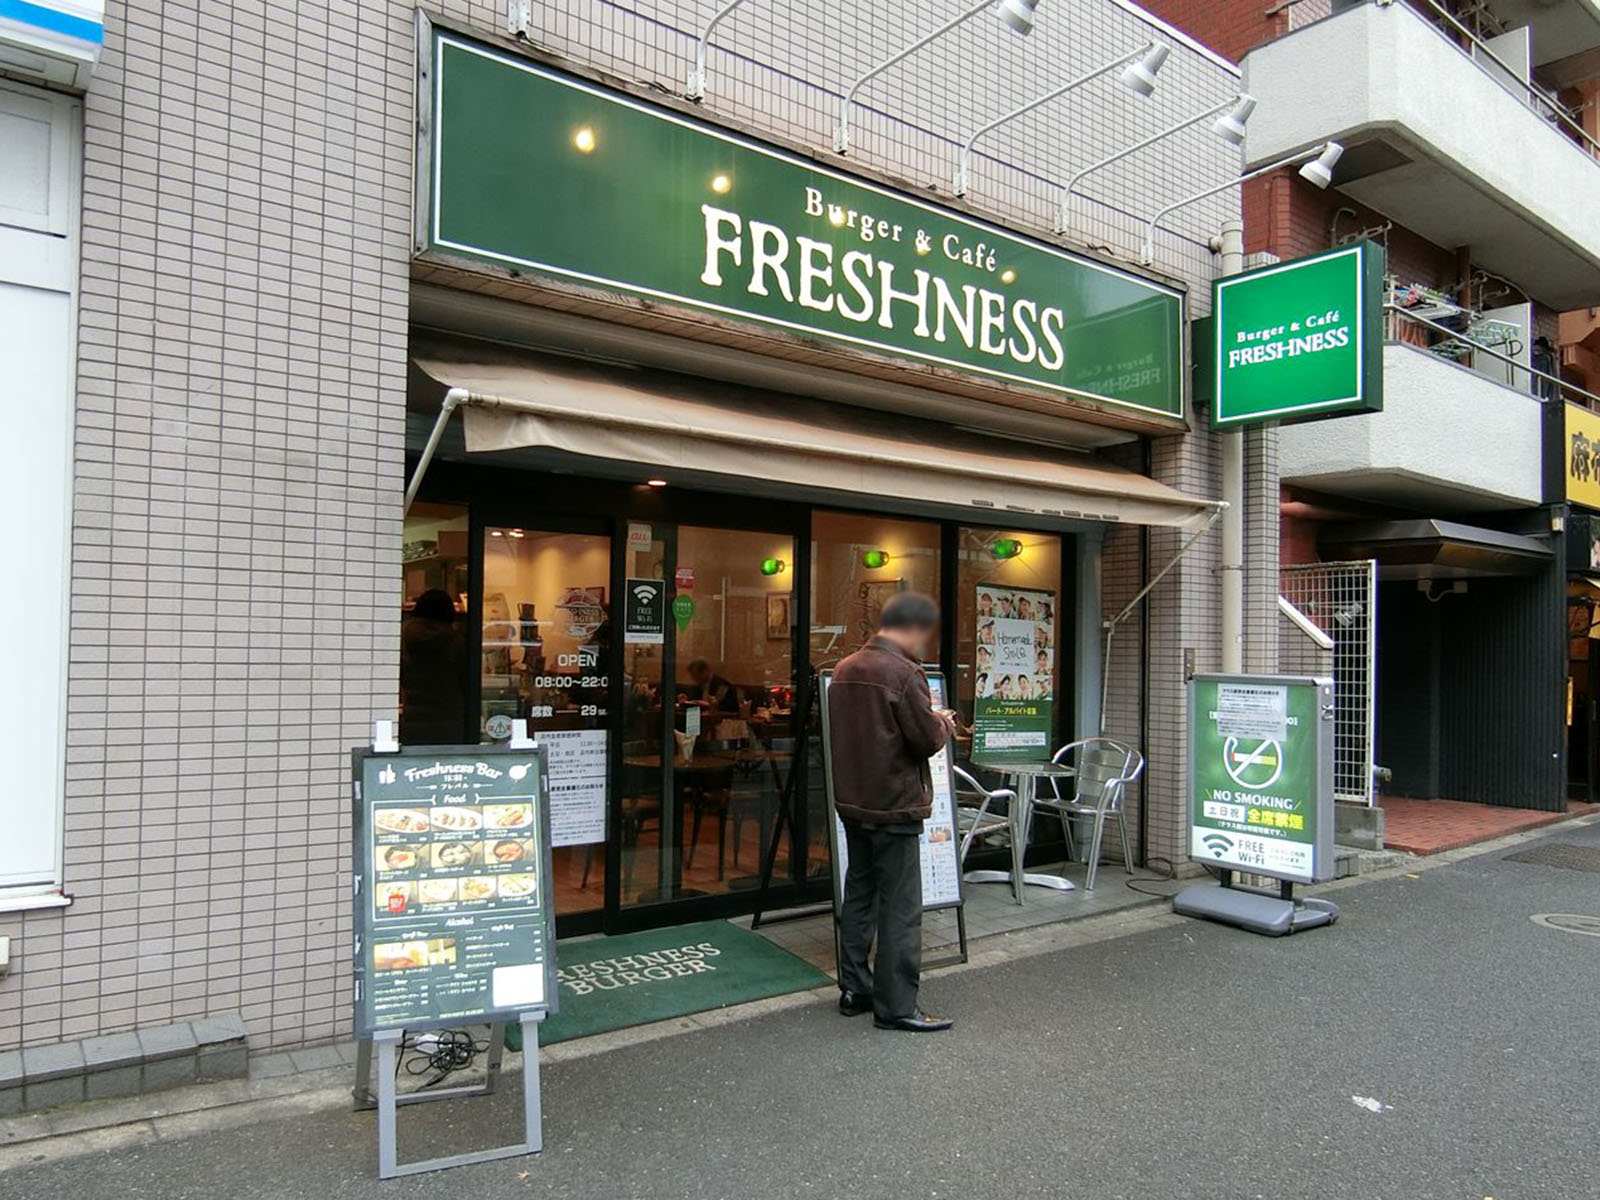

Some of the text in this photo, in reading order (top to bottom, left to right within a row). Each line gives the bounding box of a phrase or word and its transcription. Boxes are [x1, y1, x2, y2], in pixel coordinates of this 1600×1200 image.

[805, 187, 996, 272] Burger & Café
[700, 204, 1064, 371] FRESHNESS
[1237, 310, 1339, 343] Burger & Café
[1228, 326, 1349, 368] FRESHNESS
[558, 654, 596, 667] OPEN
[581, 705, 597, 716] 29
[404, 762, 503, 782] Freshness Bar
[443, 794, 467, 804] Food
[1213, 789, 1294, 810] NO SMOKING
[1208, 806, 1239, 818] 土日祝
[1239, 840, 1264, 853] FREE
[565, 959, 717, 995] BURGER
